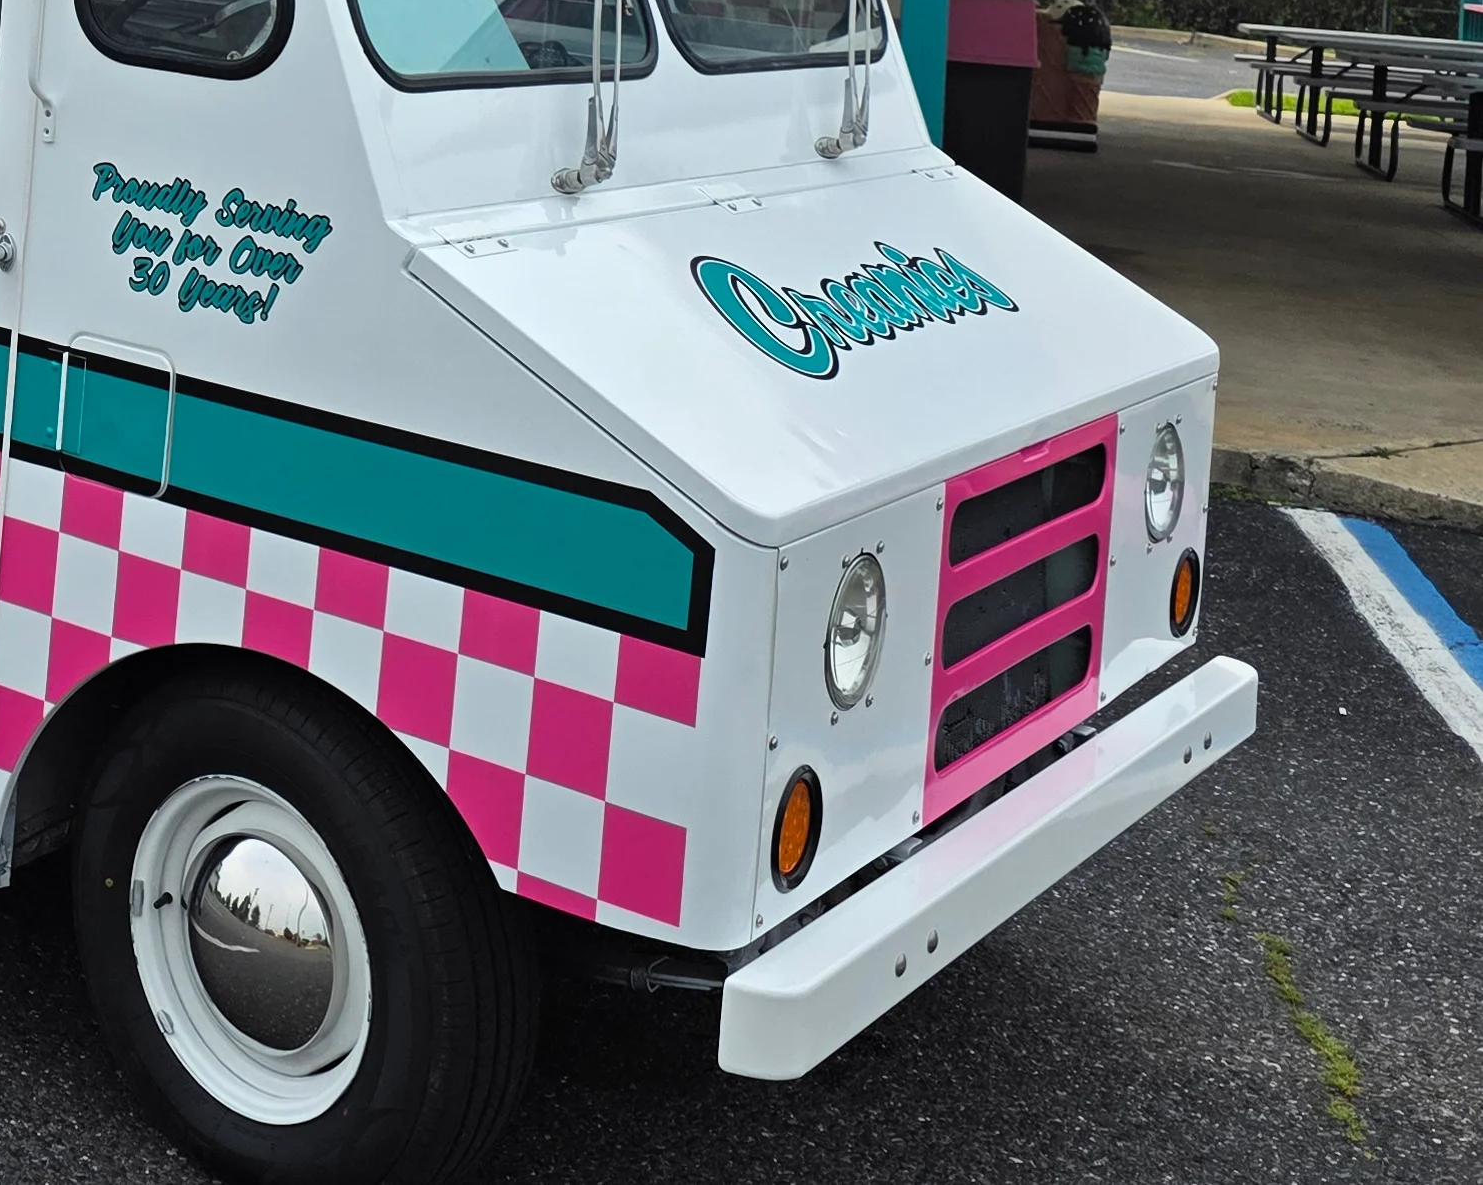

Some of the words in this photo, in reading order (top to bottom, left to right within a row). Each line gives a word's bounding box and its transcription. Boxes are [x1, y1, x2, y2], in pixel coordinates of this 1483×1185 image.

[92, 162, 208, 227] Proudly
[215, 187, 333, 254] Serving
[112, 210, 173, 255] You
[172, 229, 223, 266] for
[229, 235, 304, 285] Over
[128, 257, 170, 296] 30
[178, 267, 280, 324] Years!
[689, 241, 1020, 380] Creanies
